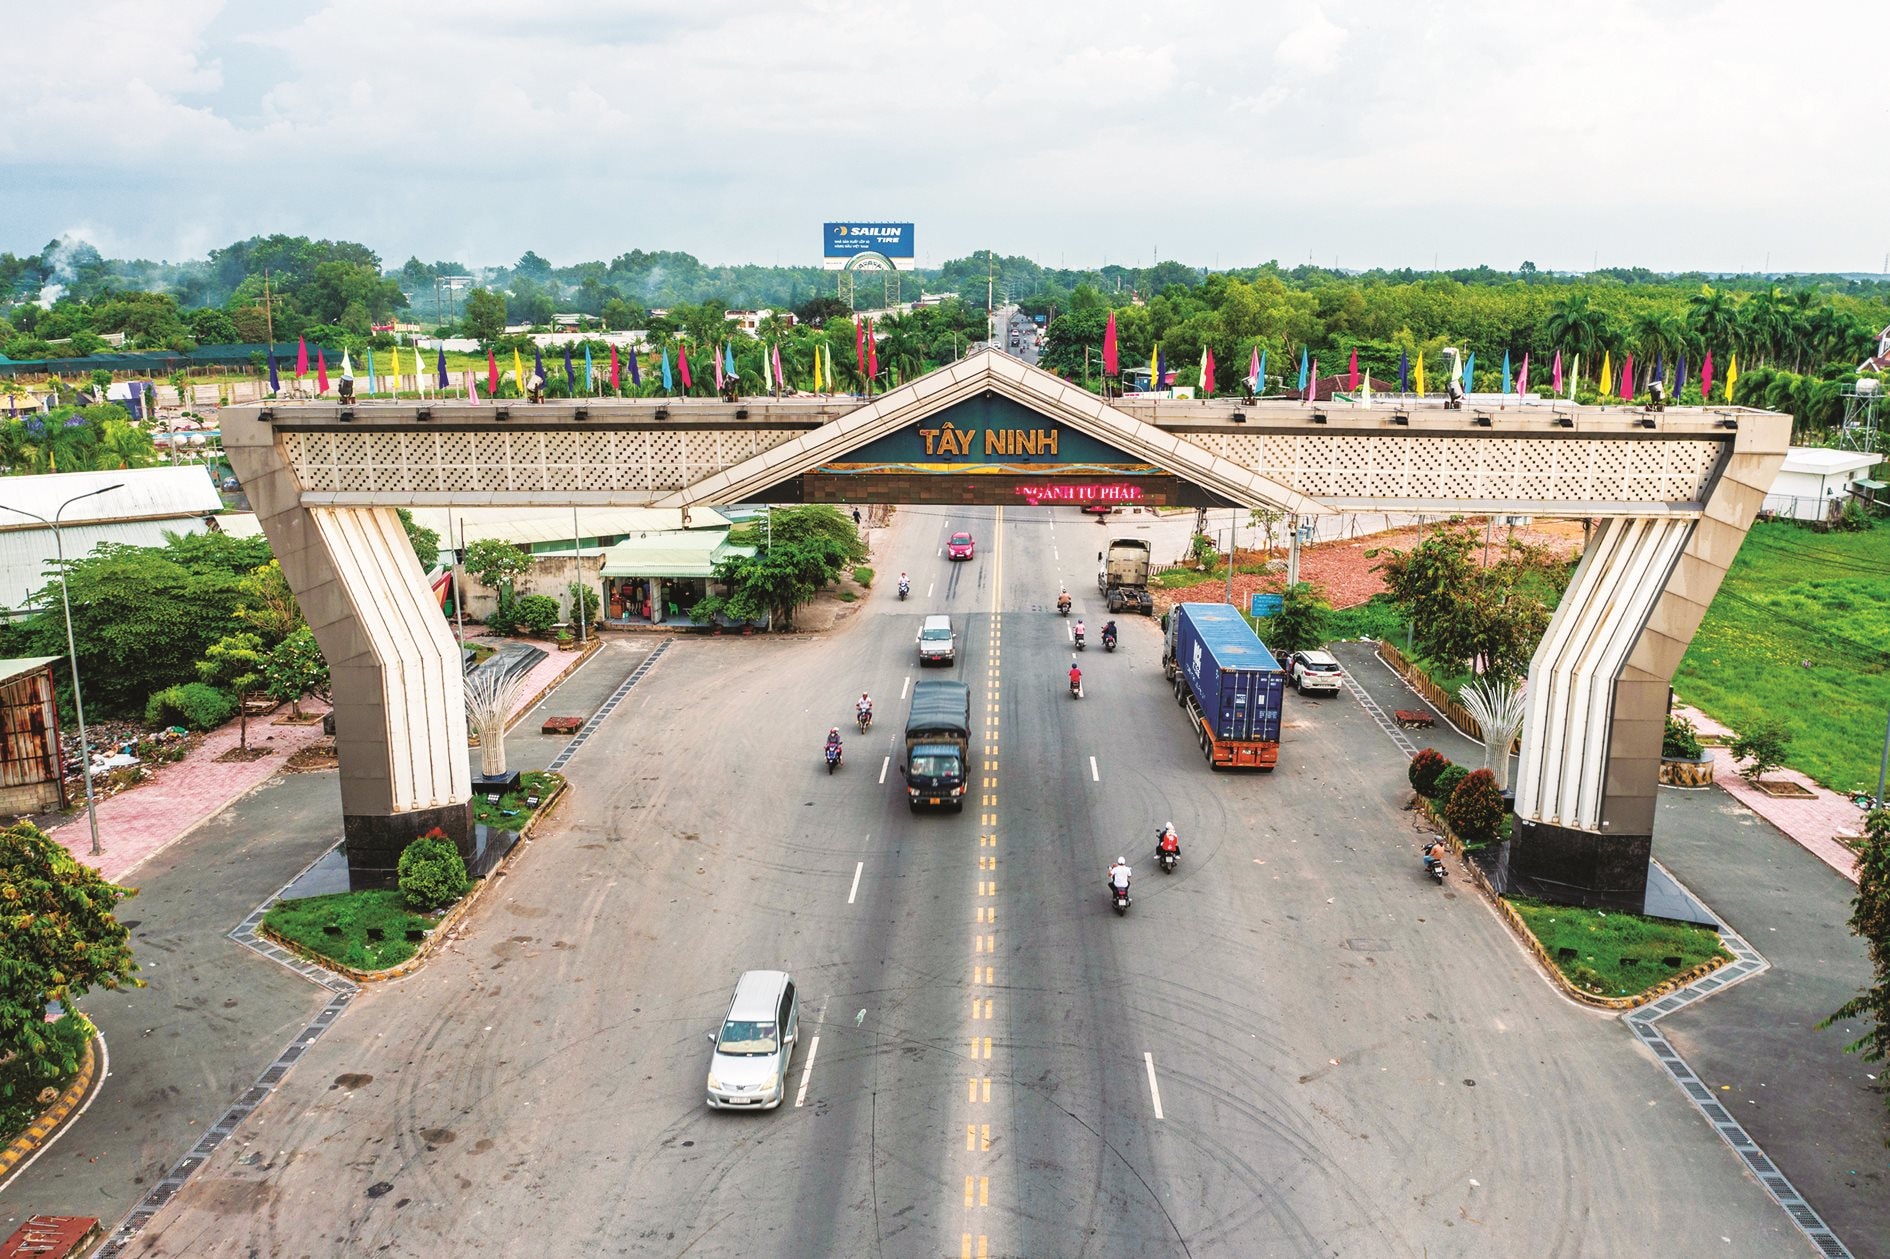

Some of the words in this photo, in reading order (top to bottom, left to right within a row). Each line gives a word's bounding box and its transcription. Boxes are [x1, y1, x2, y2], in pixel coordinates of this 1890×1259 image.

[850, 227, 901, 235] SAILUN
[919, 421, 976, 455] TÂY
[985, 429, 1058, 455] NINH
